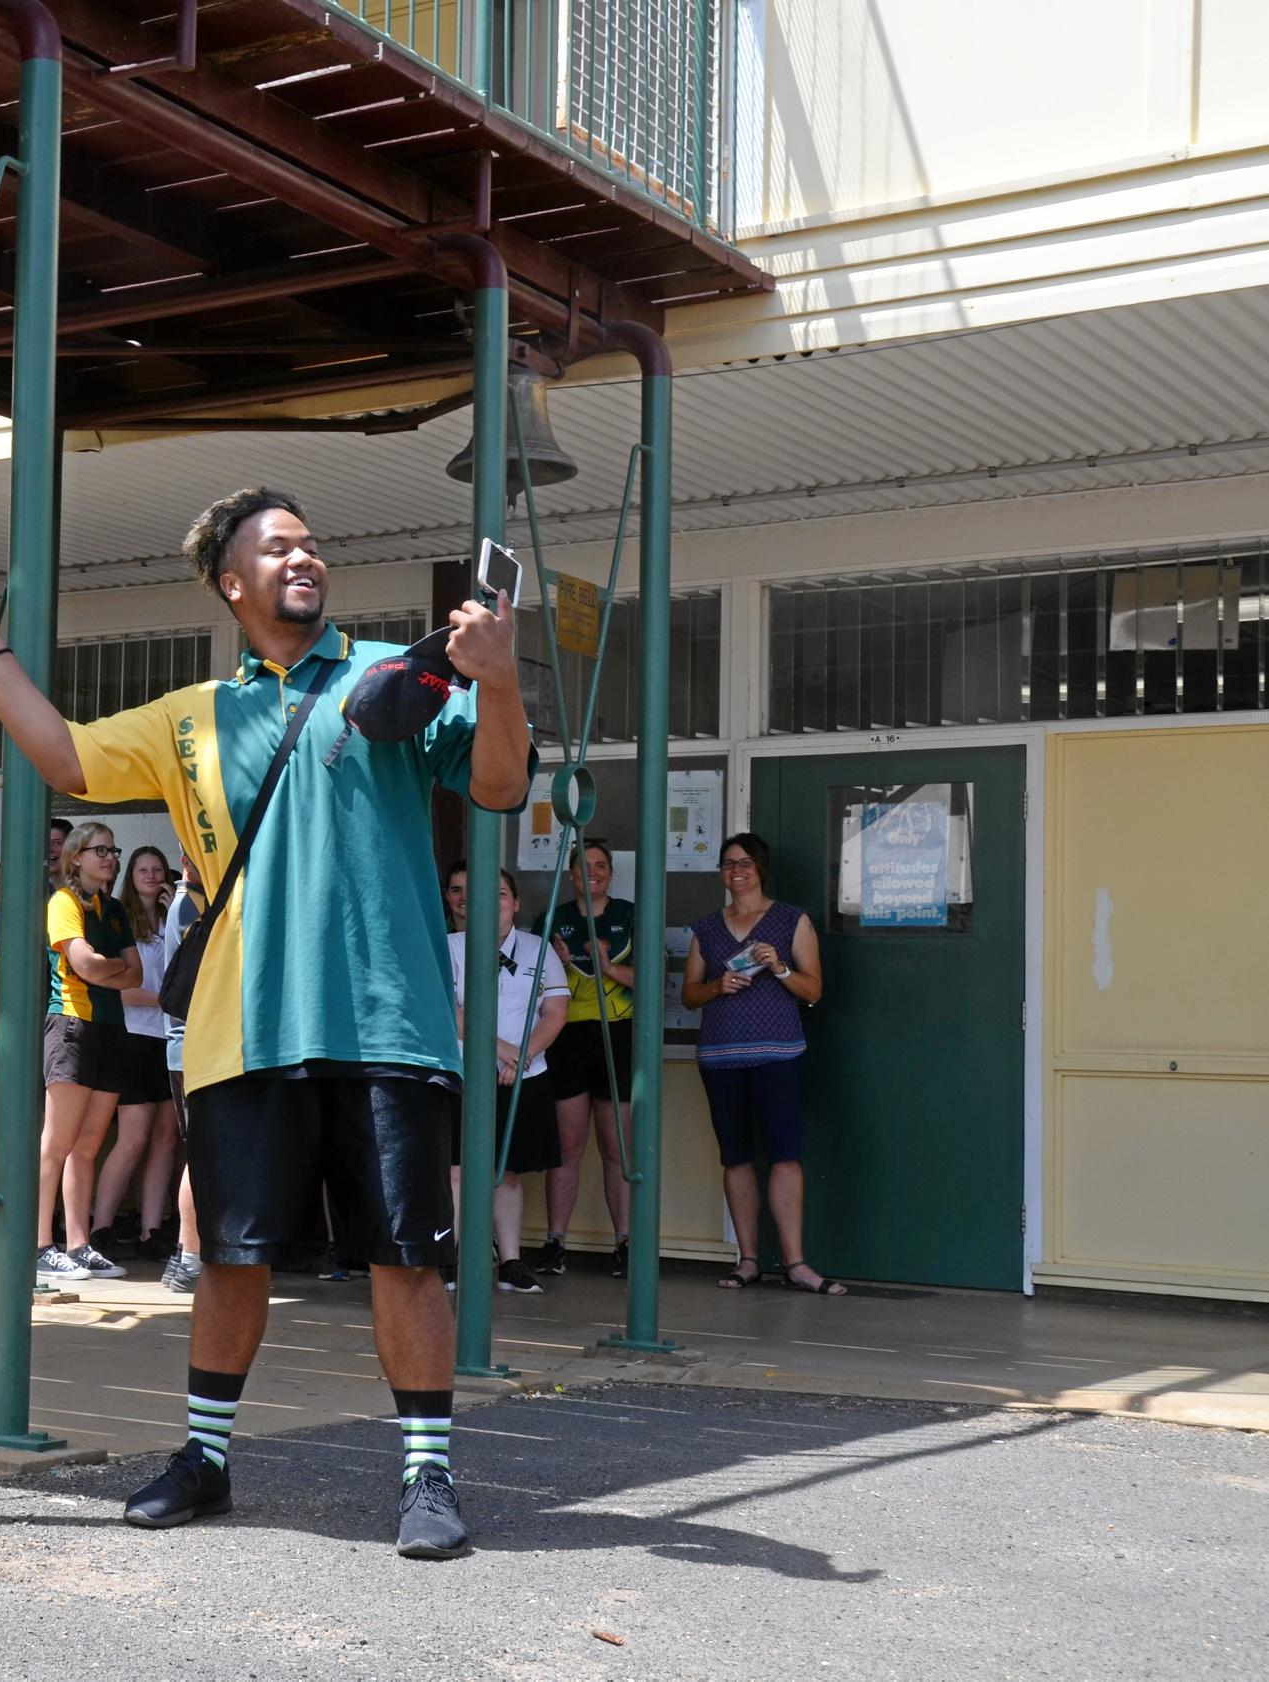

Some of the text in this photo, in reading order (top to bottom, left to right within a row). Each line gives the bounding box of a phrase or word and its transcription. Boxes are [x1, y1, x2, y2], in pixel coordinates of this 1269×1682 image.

[886, 734, 896, 743] 16
[177, 715, 218, 854] SENIOR
[869, 860, 939, 874] attitudes
[872, 875, 935, 889] allowed
[873, 889, 933, 907] beyond
[863, 905, 942, 922] this point.
